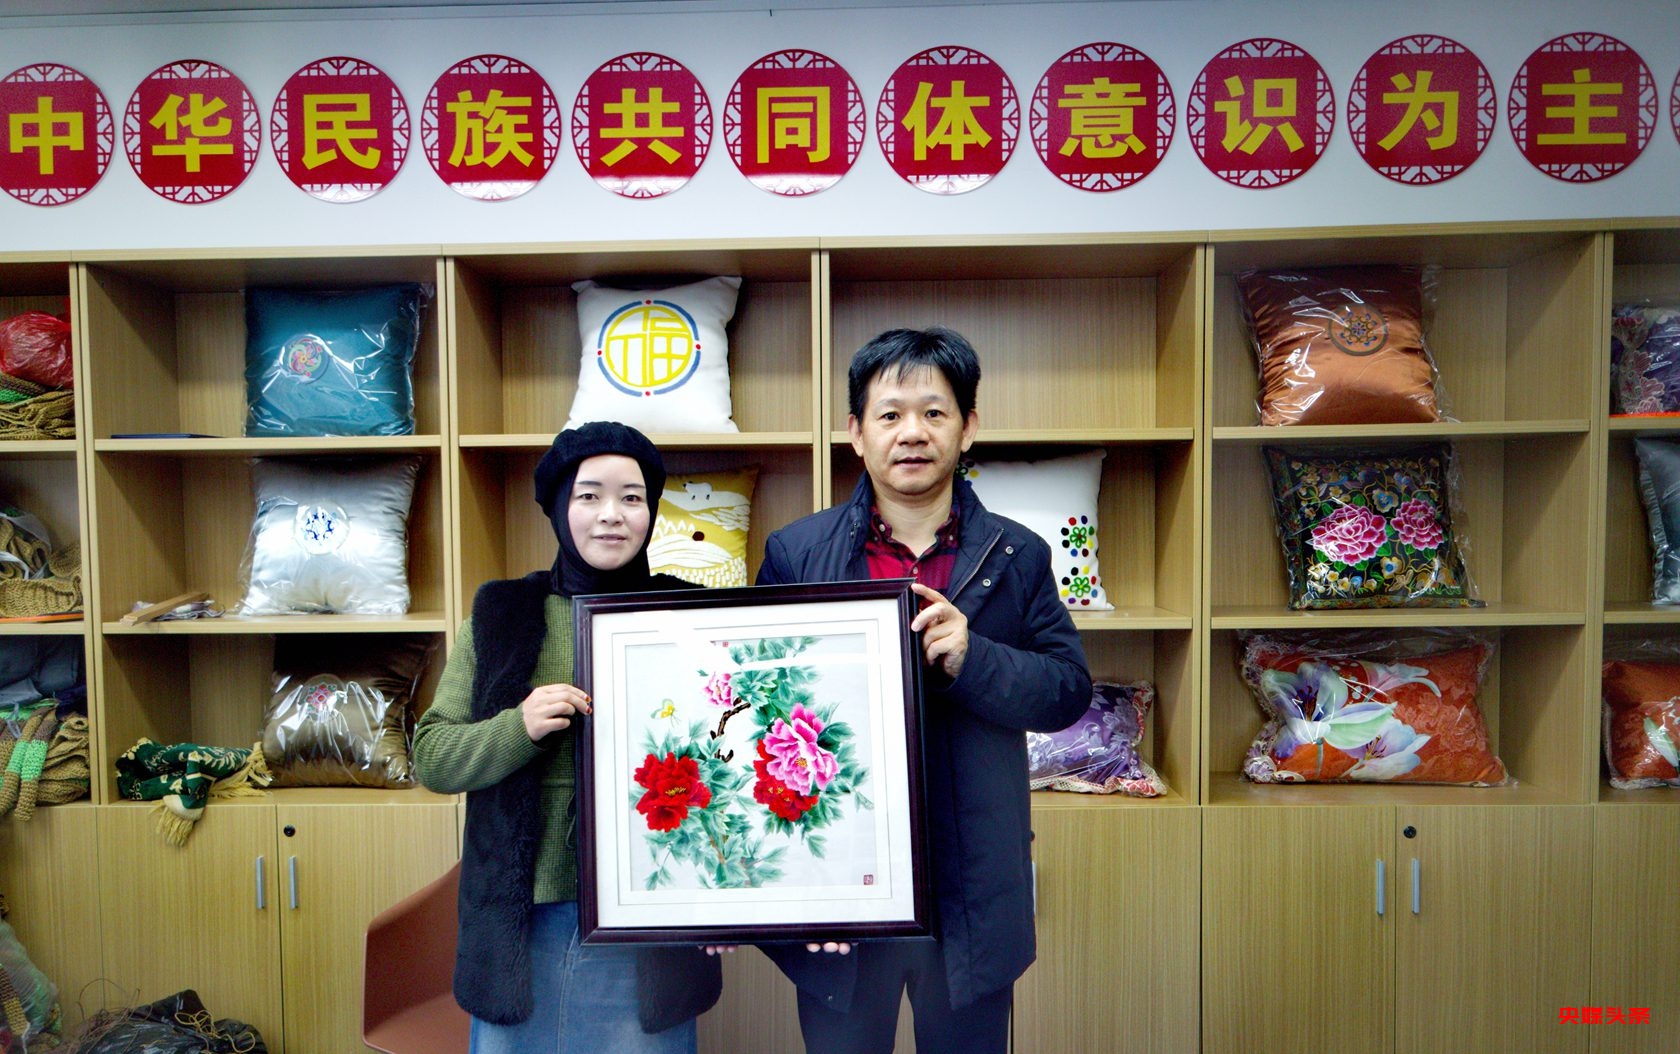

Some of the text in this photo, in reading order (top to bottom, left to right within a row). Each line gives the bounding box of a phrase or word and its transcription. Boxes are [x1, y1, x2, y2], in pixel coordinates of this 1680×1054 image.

[8, 68, 1627, 176] 中华民族共同体意识为主
[605, 305, 693, 388] 福
